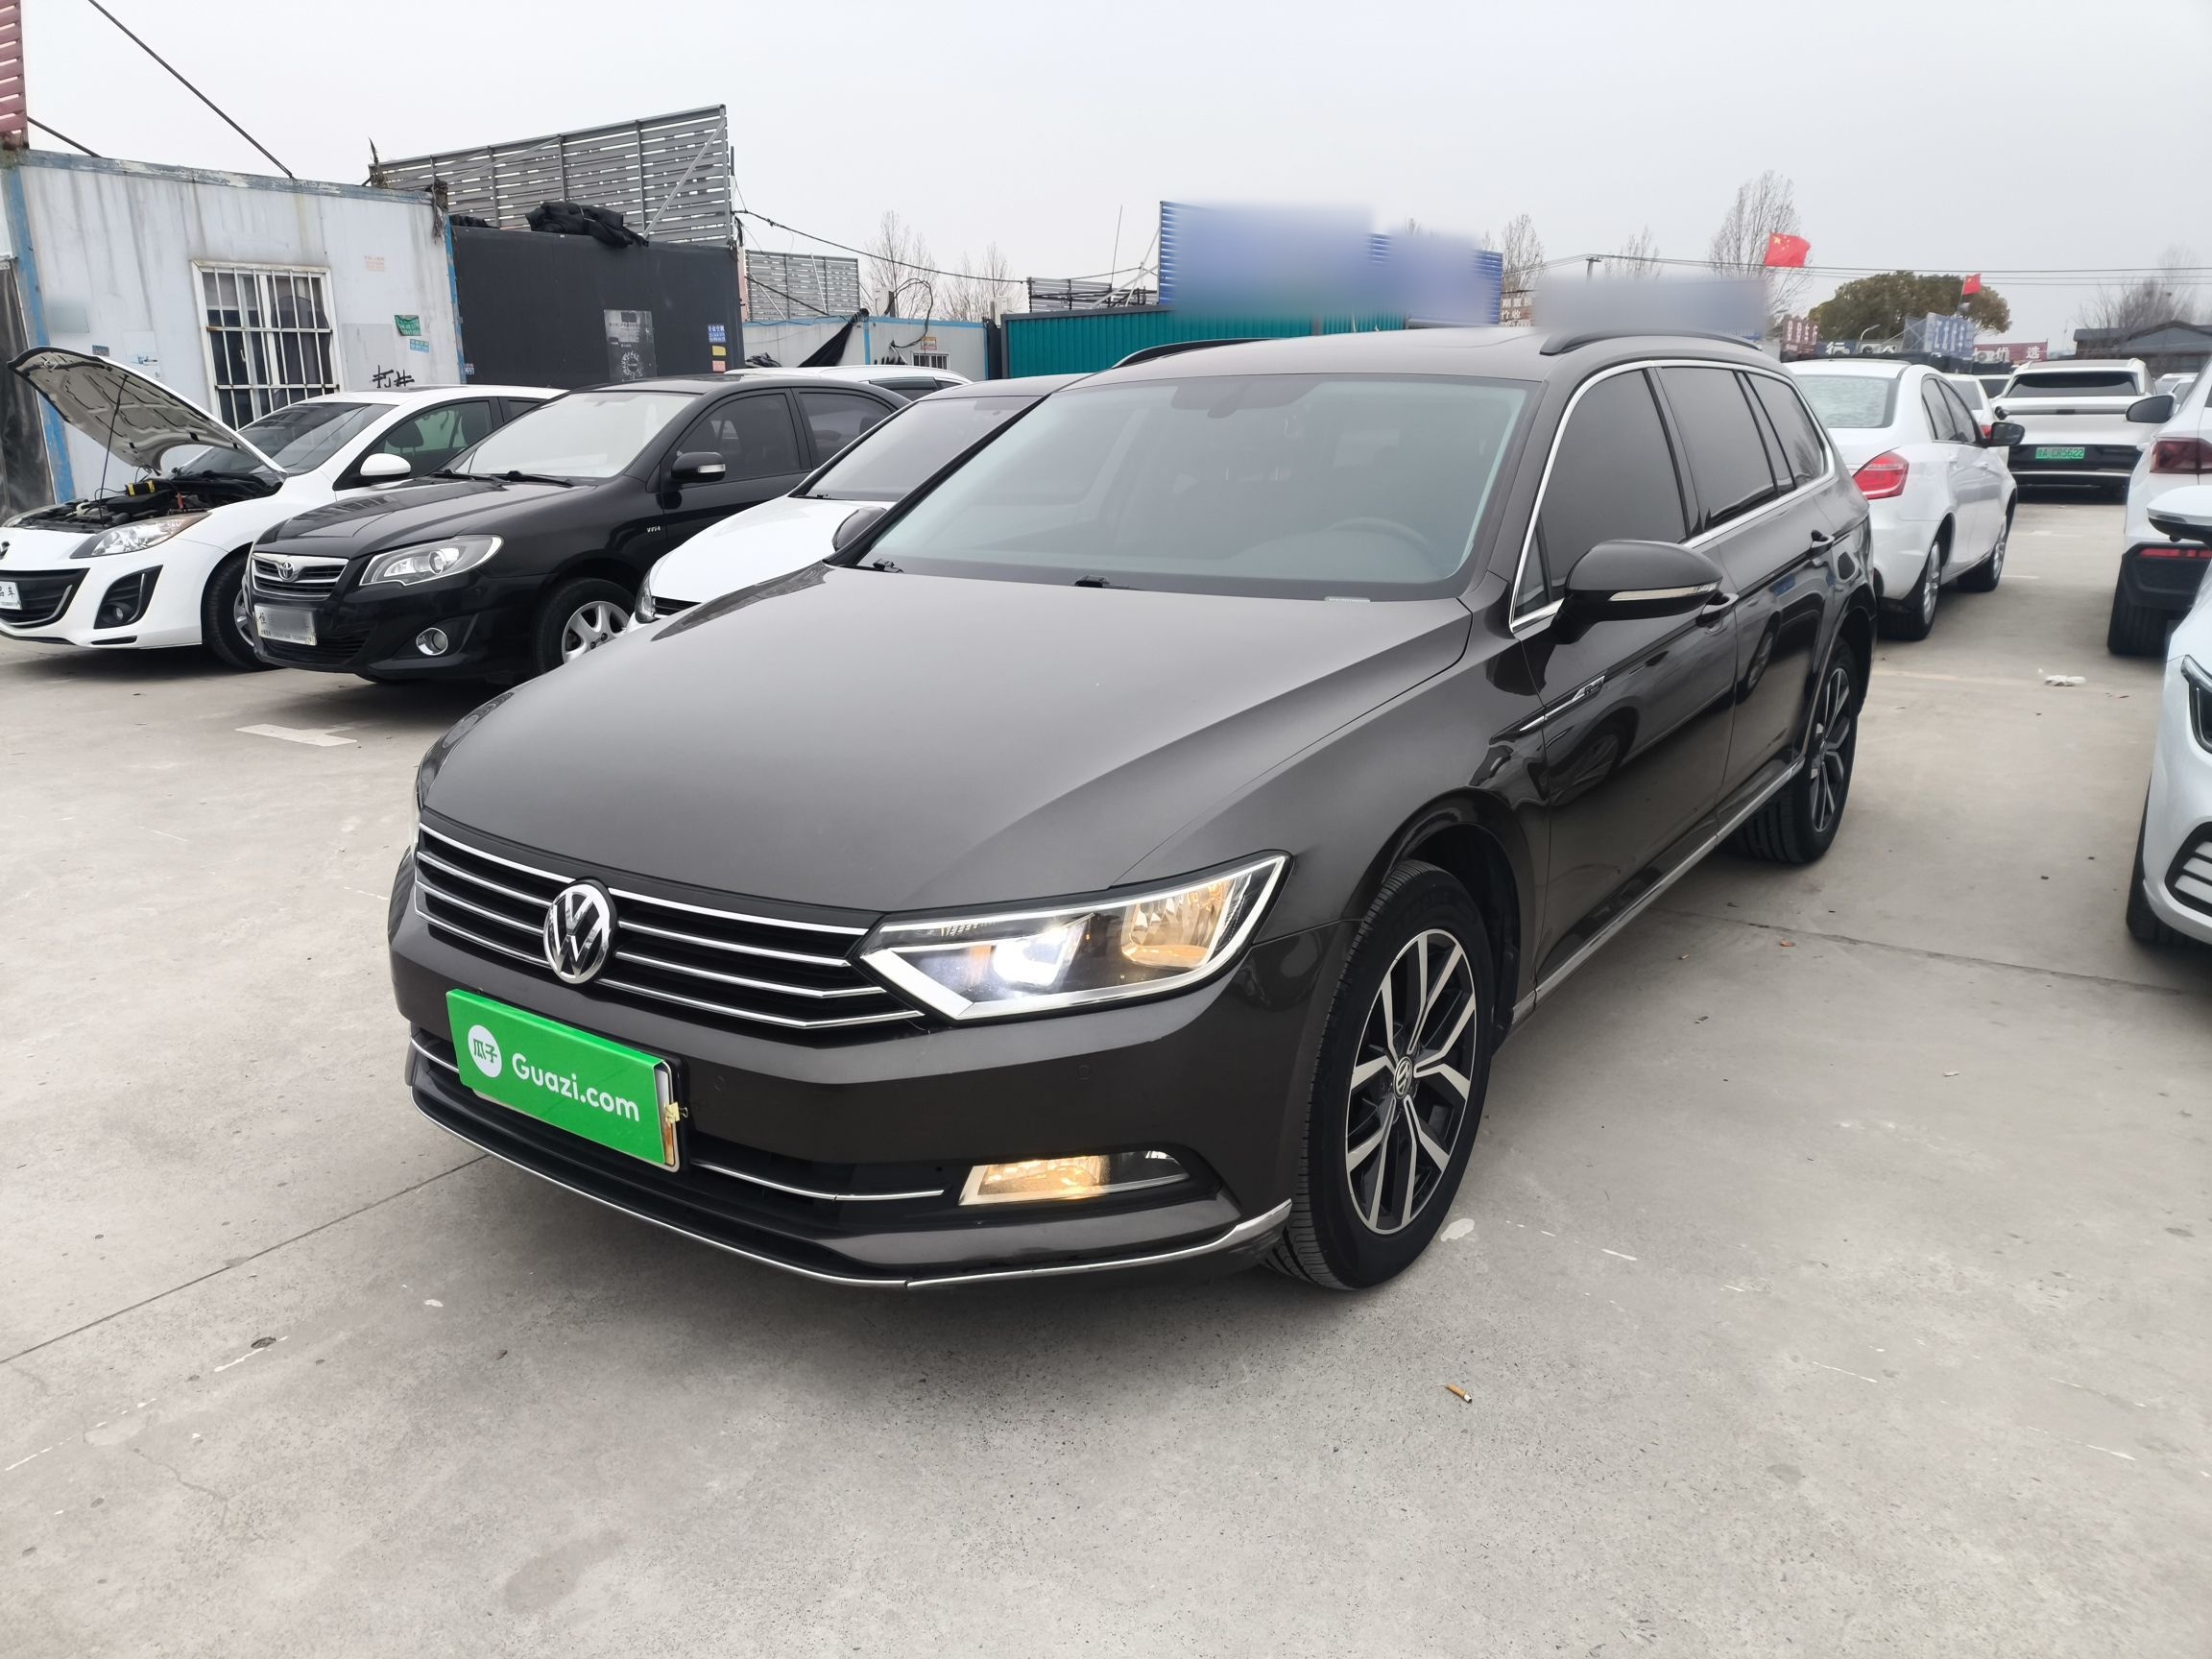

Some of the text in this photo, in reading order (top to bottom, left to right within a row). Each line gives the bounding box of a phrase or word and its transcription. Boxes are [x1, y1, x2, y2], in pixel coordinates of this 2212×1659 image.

[373, 365, 415, 389] 打井
[545, 885, 609, 982] VW
[472, 1038, 498, 1064] 瓜子
[512, 1052, 640, 1122] Guazi.com
